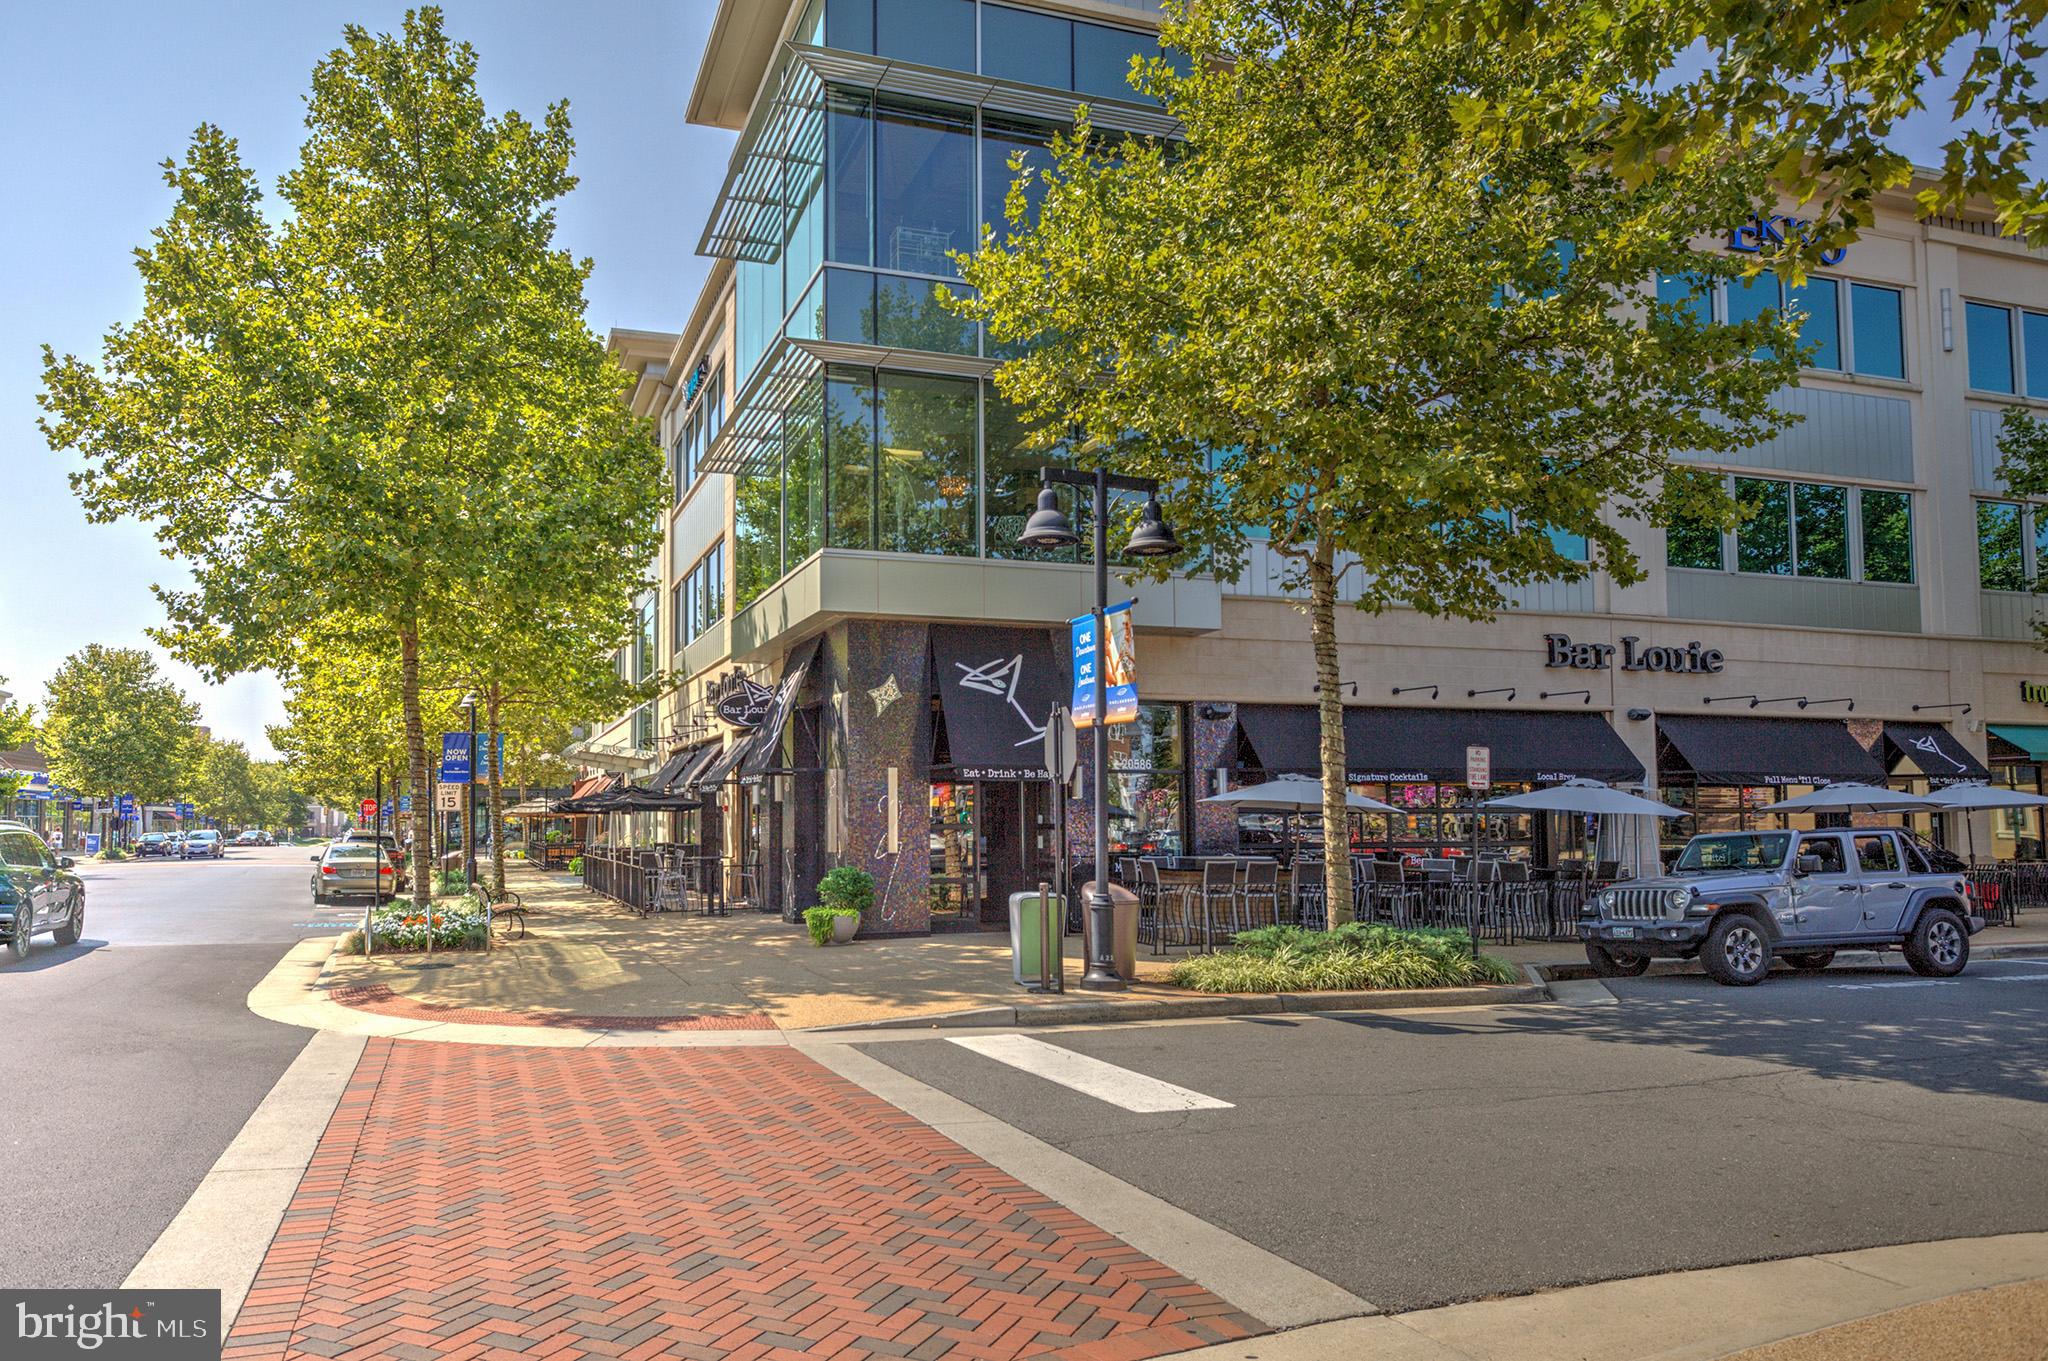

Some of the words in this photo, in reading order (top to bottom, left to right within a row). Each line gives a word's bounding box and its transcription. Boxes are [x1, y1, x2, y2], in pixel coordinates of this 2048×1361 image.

[1079, 632, 1092, 645] ONE
[1543, 633, 1616, 669] Bar
[1620, 636, 1724, 673] Louie
[1080, 662, 1092, 675] ONE
[723, 705, 742, 714] Bar
[744, 705, 769, 715] Loui
[1121, 759, 1152, 769] 20586
[963, 769, 980, 778] Eat
[987, 769, 1016, 778] Drink
[1024, 769, 1036, 778] Be
[1348, 773, 1388, 782] Signature
[1389, 772, 1429, 781] Cocktails
[1537, 773, 1557, 781] Local
[1764, 776, 1780, 784] Full
[1781, 776, 1798, 784] Menu
[1813, 776, 1832, 785] Close
[441, 796, 457, 808] 15
